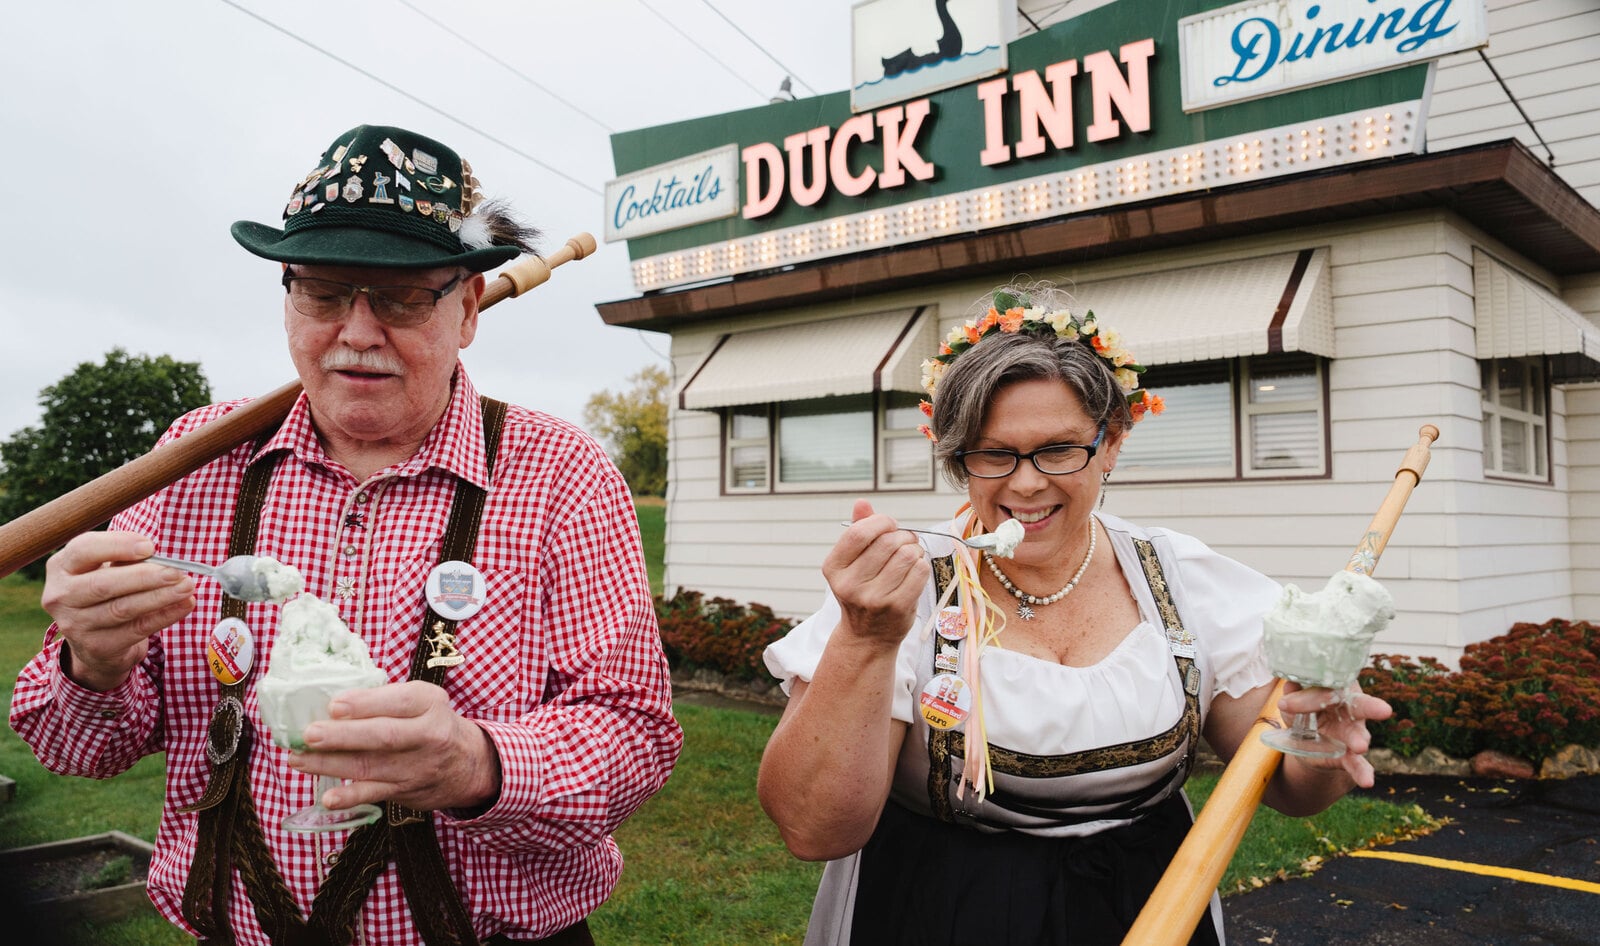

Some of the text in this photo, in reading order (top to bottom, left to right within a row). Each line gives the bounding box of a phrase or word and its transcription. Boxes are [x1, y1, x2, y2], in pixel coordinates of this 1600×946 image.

[1213, 0, 1459, 87] Dining
[741, 38, 1156, 221] DUCK INN
[614, 164, 725, 230] Cocktails
[212, 659, 223, 675] Phil
[925, 711, 947, 727] Laura
